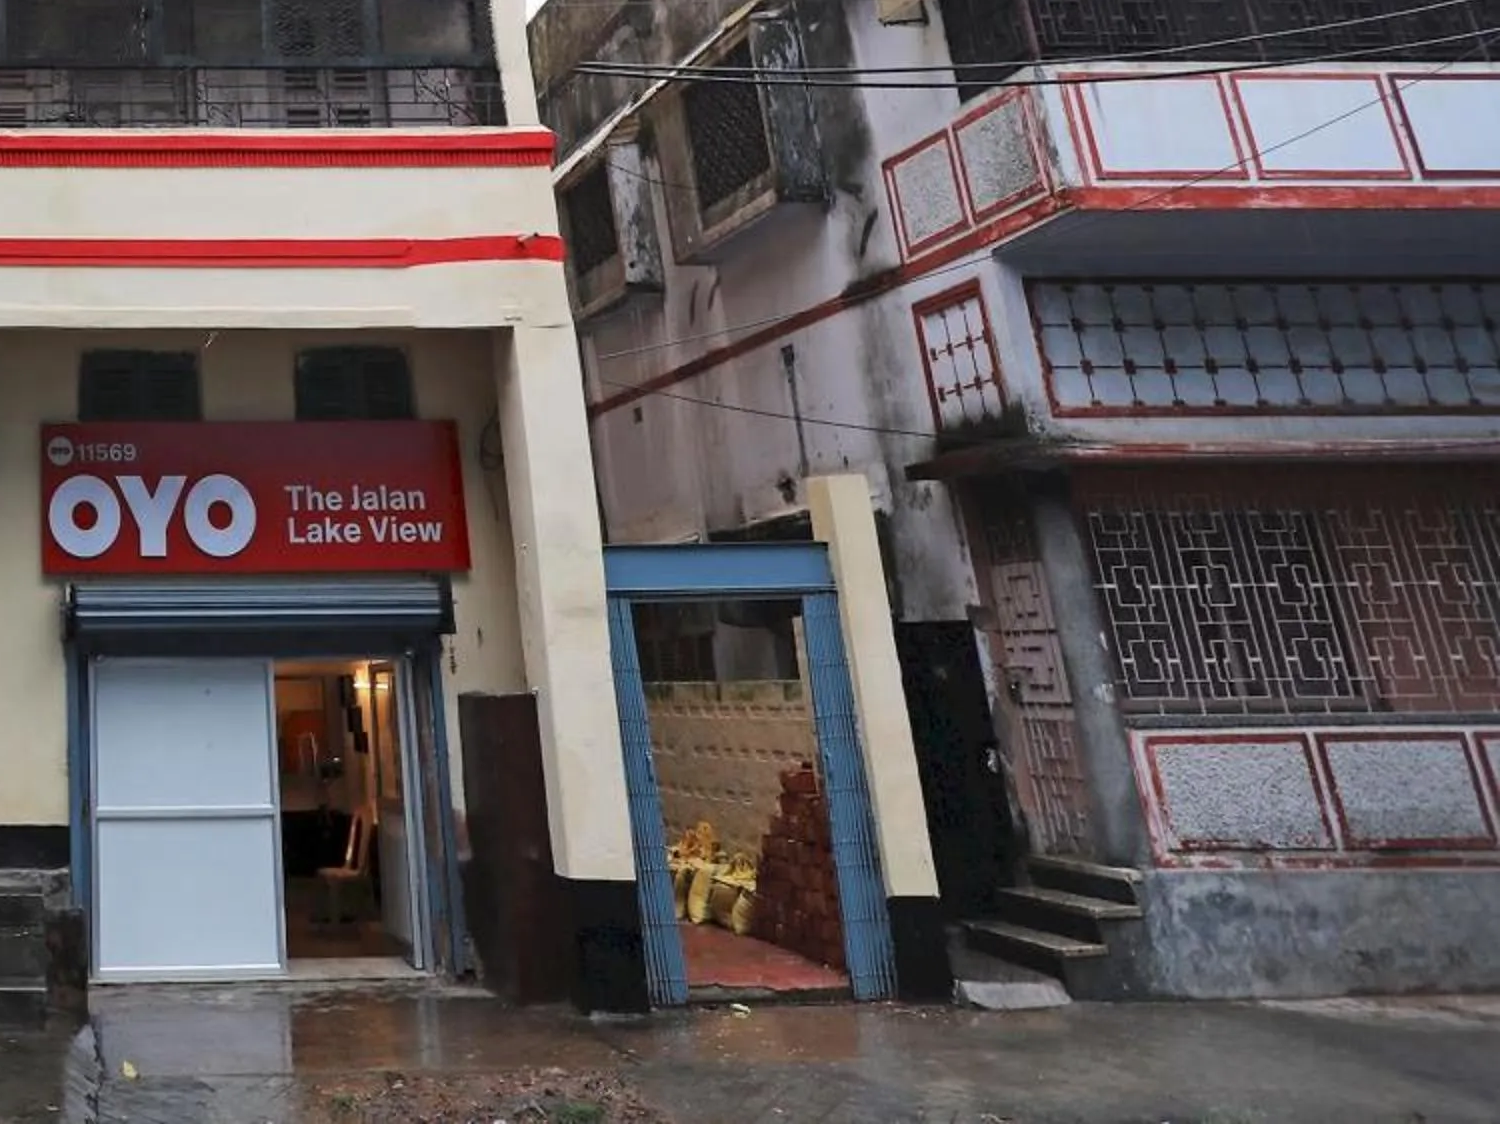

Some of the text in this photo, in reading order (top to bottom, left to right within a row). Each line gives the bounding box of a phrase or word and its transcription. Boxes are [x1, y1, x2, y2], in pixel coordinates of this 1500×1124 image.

[76, 443, 137, 462] 11569
[284, 484, 426, 511] The Jalan
[49, 474, 257, 558] OYO
[287, 516, 443, 543] Lake View
